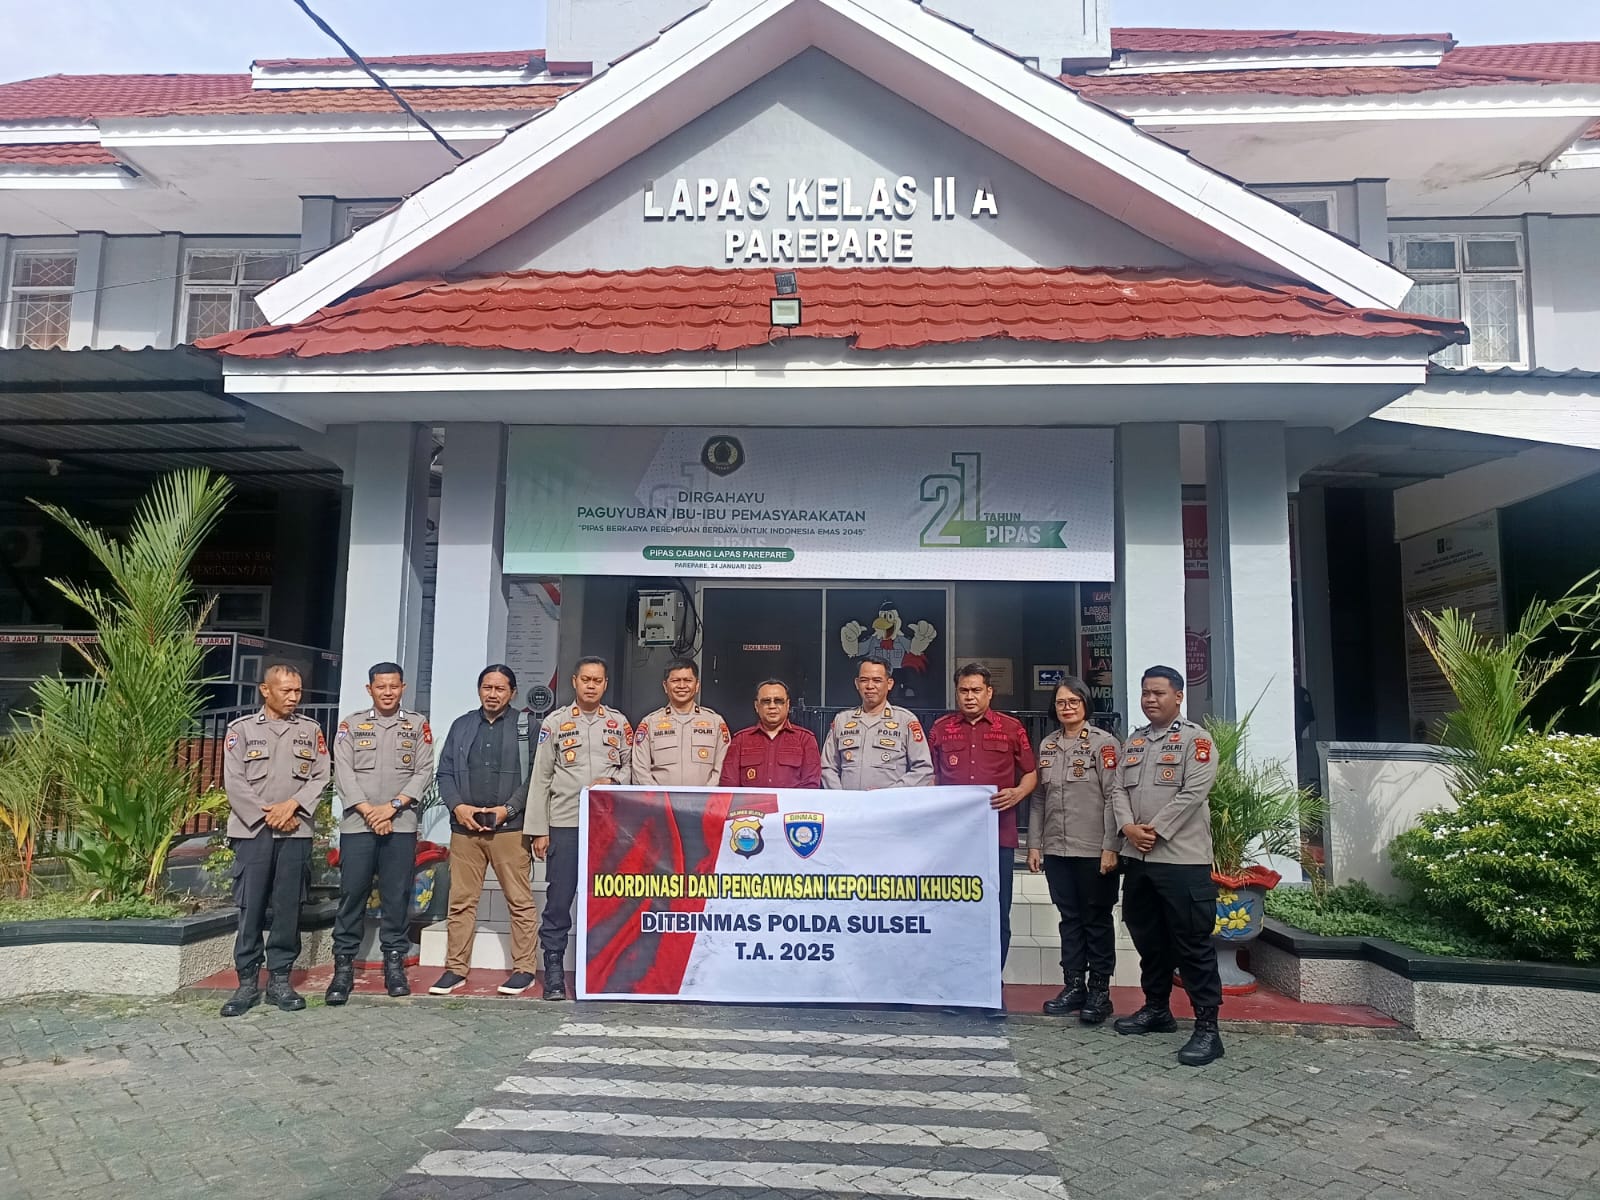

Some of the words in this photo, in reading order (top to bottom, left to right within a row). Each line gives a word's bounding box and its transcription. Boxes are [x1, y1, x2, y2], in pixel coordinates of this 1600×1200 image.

[644, 176, 771, 221] LAPAS
[787, 176, 917, 221] KELAS
[932, 176, 956, 221] II
[971, 177, 999, 217] A
[725, 227, 914, 262] PAREPARE
[678, 491, 765, 503] DIRGAHAYU
[919, 452, 982, 548] 21
[577, 506, 667, 519] PAGUYUBAN
[672, 508, 726, 520] IBU-IBU
[732, 509, 866, 522] PEMASYARAKATAN
[984, 512, 1021, 522] TAHUN
[650, 525, 700, 533] PEREMPUAN
[740, 527, 768, 535] UNTUK
[985, 525, 1041, 544] PIPAS
[649, 549, 674, 557] PIPAS
[676, 549, 711, 558] CABANG
[714, 550, 741, 558] LAPAS
[743, 551, 787, 559] PAREPARE
[603, 728, 622, 737] POLRI
[877, 729, 901, 737] POLRI
[593, 873, 684, 898] KOORDINASI
[687, 874, 719, 898] DAN
[722, 875, 825, 899] PENGAWASAN
[827, 876, 917, 901] KEPOLISIAN
[920, 876, 983, 901] KHUSUS
[641, 913, 762, 933] DITBINMAS
[768, 914, 841, 933] POLDA
[847, 915, 931, 935] SULSEL
[735, 943, 774, 961] T.A.
[780, 943, 835, 961] 2025
